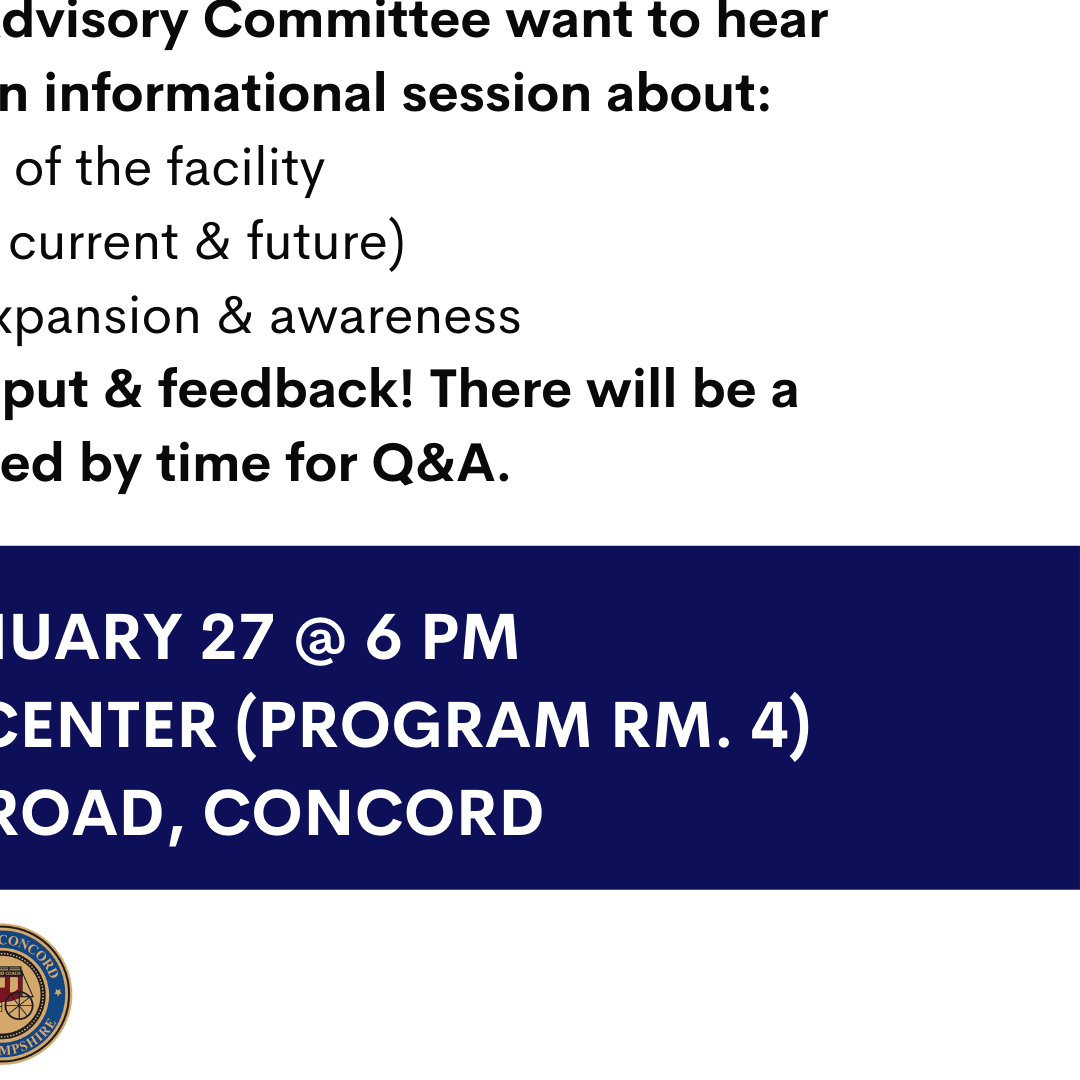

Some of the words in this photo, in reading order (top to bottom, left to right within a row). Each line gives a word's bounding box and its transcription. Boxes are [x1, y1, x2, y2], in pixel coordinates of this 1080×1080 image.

[506, 2, 632, 38] want
[648, 2, 699, 38] to
[46, 71, 384, 112] informational
[403, 72, 589, 112] session
[608, 71, 769, 112] about:
[16, 145, 61, 186] of
[76, 145, 150, 186] the
[167, 145, 324, 198] facility
[10, 225, 177, 260] current
[197, 222, 229, 260] &
[247, 217, 403, 272] future)
[219, 296, 251, 334] &
[271, 307, 519, 334] awareness
[105, 369, 141, 408] &
[158, 367, 411, 408] feedback!
[430, 367, 570, 408] There
[586, 367, 674, 407] will
[695, 367, 755, 408] be
[772, 380, 797, 408] a
[83, 441, 142, 494] by
[156, 442, 270, 482] time
[286, 441, 357, 482] for
[373, 443, 508, 485] Q&A.
[202, 613, 273, 659] 27
[296, 617, 345, 666] @
[367, 614, 401, 660] 6
[425, 614, 517, 659] PM
[237, 692, 589, 762] (PROGRAM
[615, 702, 729, 748] RM.
[752, 692, 808, 762] 4)
[205, 789, 542, 836] CONCORD
